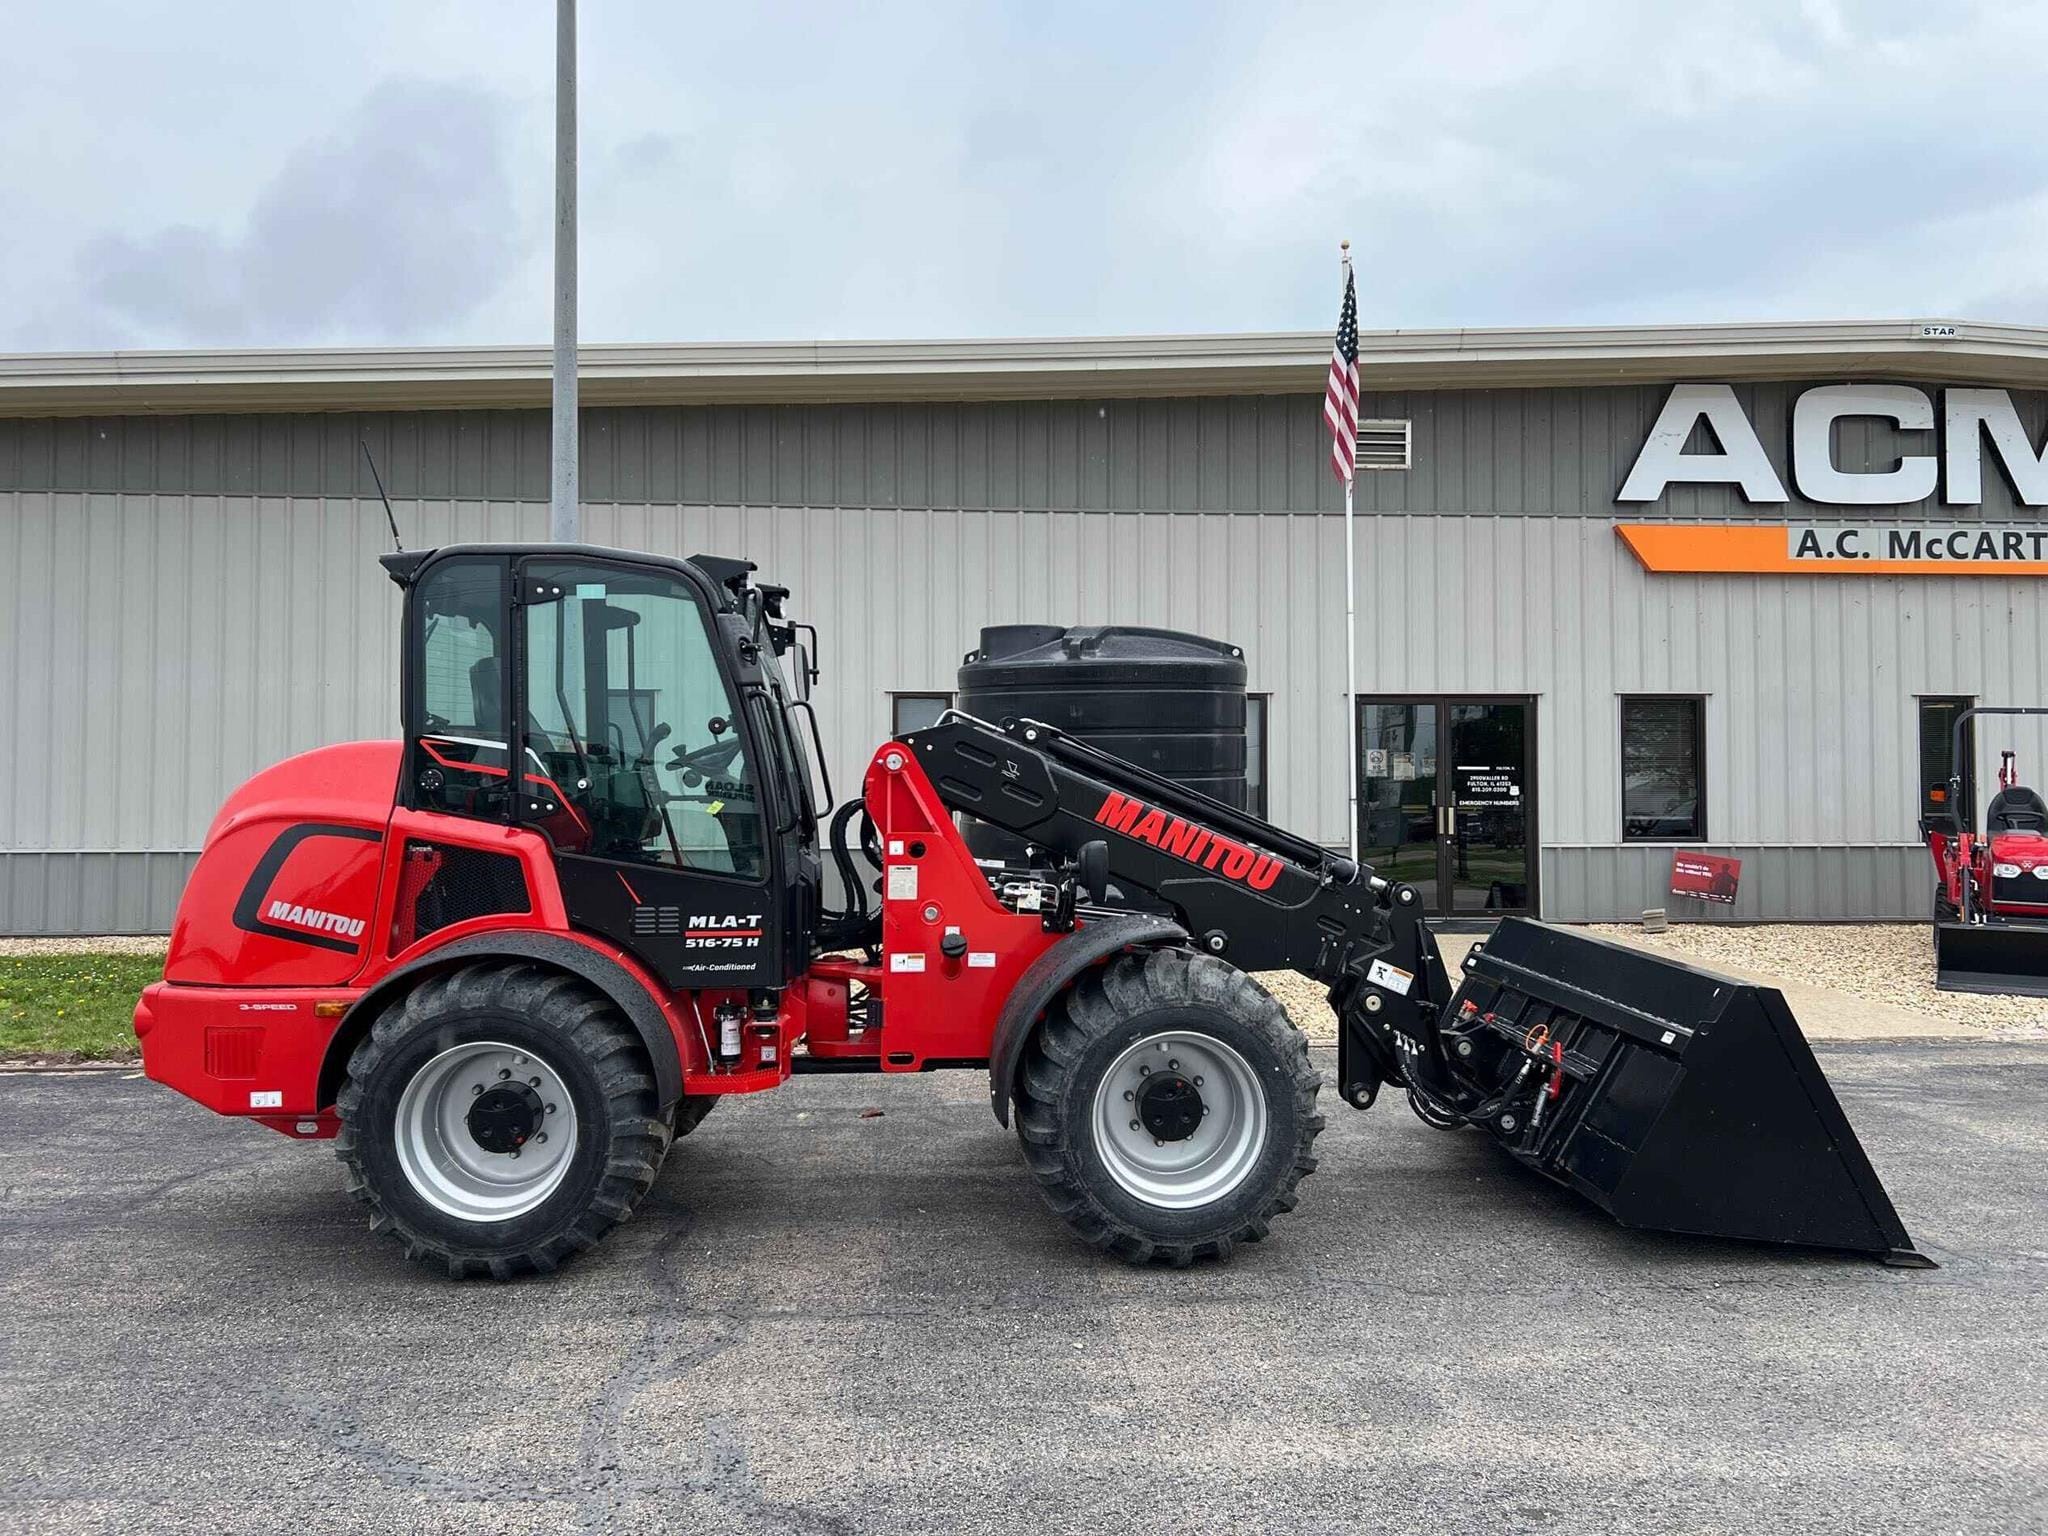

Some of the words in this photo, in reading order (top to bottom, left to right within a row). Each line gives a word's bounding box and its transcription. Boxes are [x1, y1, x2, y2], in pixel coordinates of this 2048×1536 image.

[1923, 327, 1955, 336] STAR
[1617, 384, 2048, 505] ACM
[1796, 529, 1870, 559] A.C.
[1889, 530, 2048, 560] McCART
[1094, 791, 1285, 880] MANITOU
[267, 900, 366, 937] MANITOU
[688, 915, 762, 929] MLA-T
[685, 938, 743, 948] 516-75
[746, 937, 760, 947] H
[694, 963, 757, 972] Air-Conditioned
[239, 1003, 298, 1011] 3-SPEED
